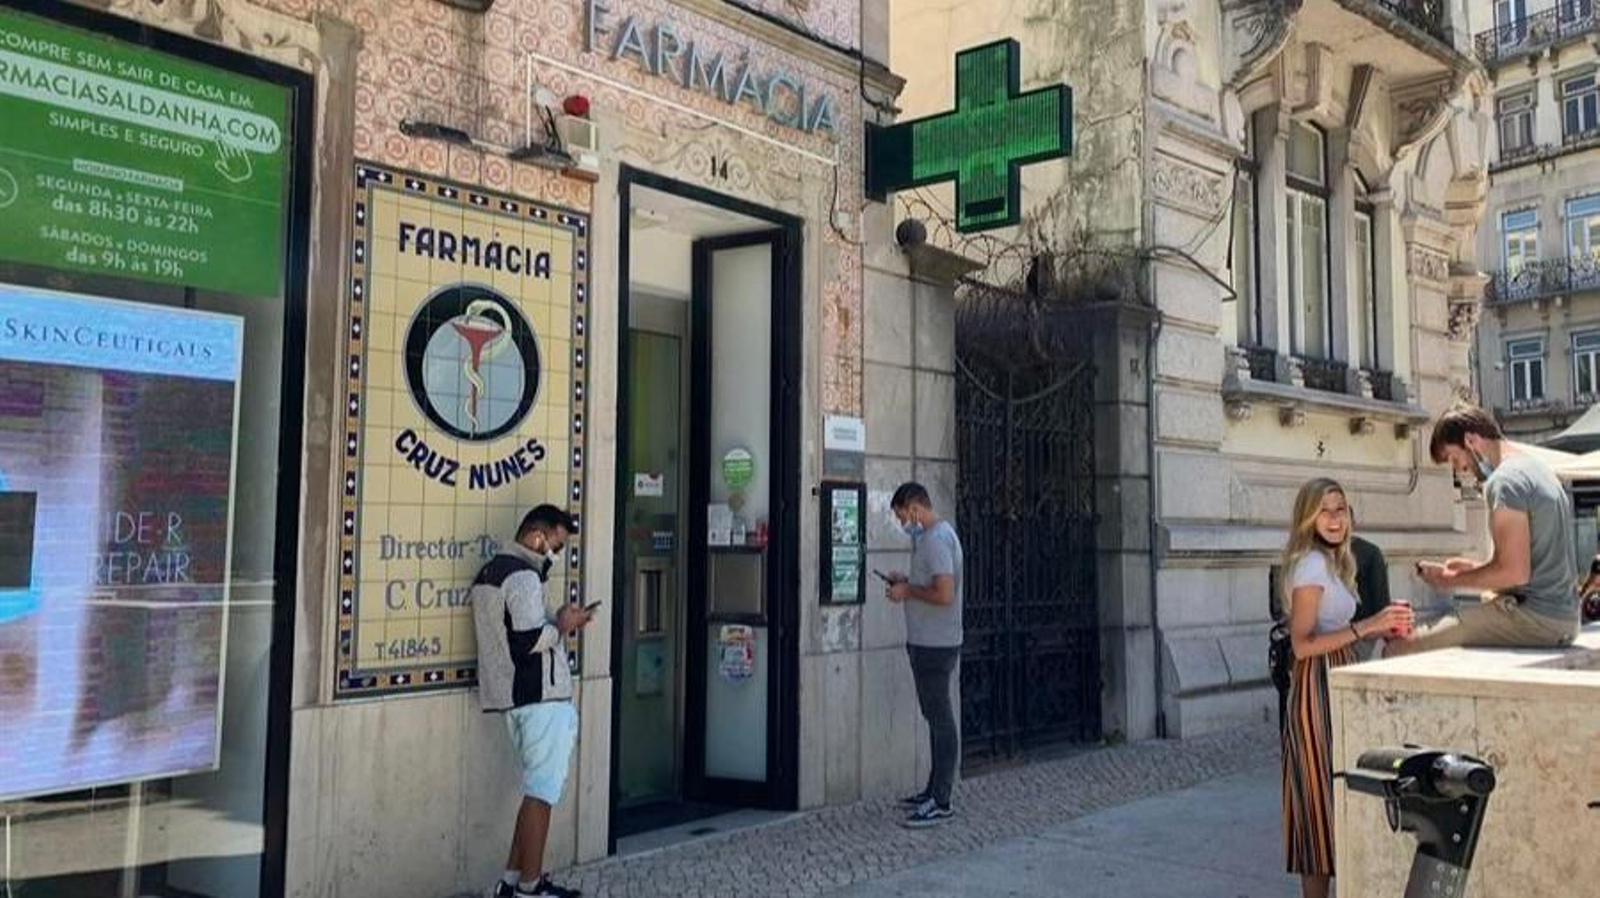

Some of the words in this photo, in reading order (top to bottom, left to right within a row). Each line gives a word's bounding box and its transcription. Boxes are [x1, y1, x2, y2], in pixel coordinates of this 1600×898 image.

[77, 50, 112, 72] SEM
[118, 61, 154, 83] SAIR
[160, 72, 181, 91] DE
[185, 80, 225, 102] CASA
[48, 111, 119, 139] SIMPLES
[125, 127, 134, 143] E
[139, 131, 205, 158] SEGURO
[35, 174, 113, 201] SEGUNDA
[711, 155, 728, 182] 14
[52, 194, 83, 214] das
[88, 199, 139, 224] 8h30
[166, 212, 200, 236] 22h
[65, 245, 97, 266] das
[102, 250, 127, 271] 9h
[153, 257, 185, 279] 19h
[127, 238, 209, 265] DOMINGOS
[399, 222, 551, 280] FARMÁCIA
[395, 428, 461, 488] CRUZ
[468, 438, 546, 491] NUNES
[87, 550, 191, 584] REPAIR
